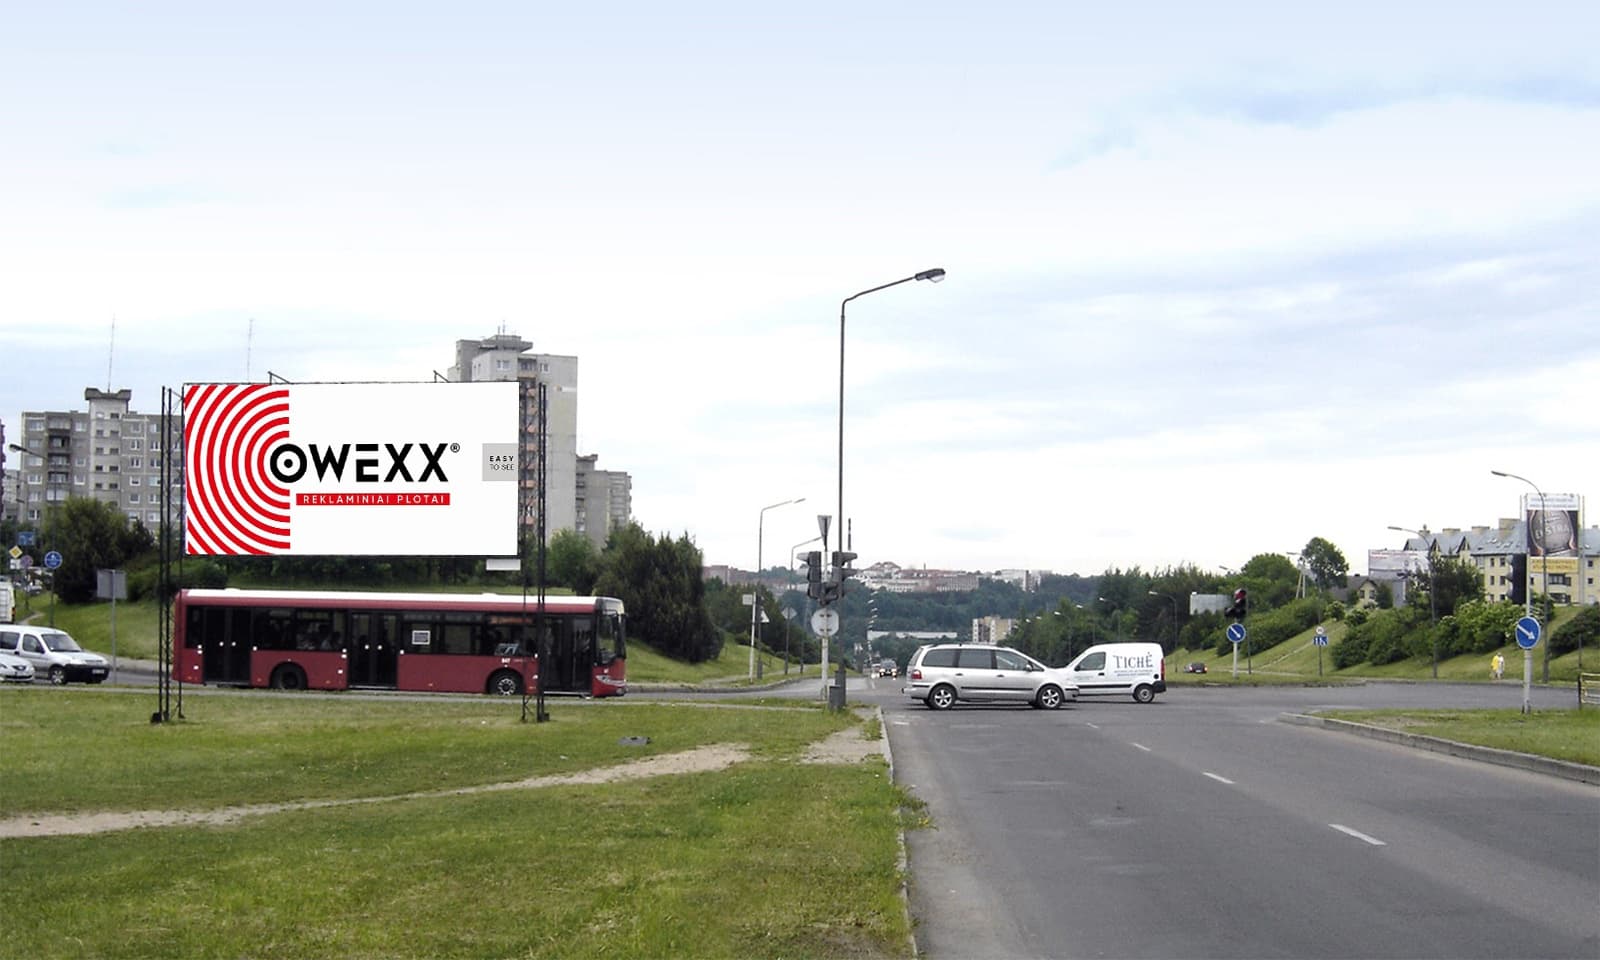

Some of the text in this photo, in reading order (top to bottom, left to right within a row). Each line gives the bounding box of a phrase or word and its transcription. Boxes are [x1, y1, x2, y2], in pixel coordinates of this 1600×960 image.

[489, 463, 515, 471] TO SEE
[303, 494, 444, 504] REKLAMINIAI PLOTAI
